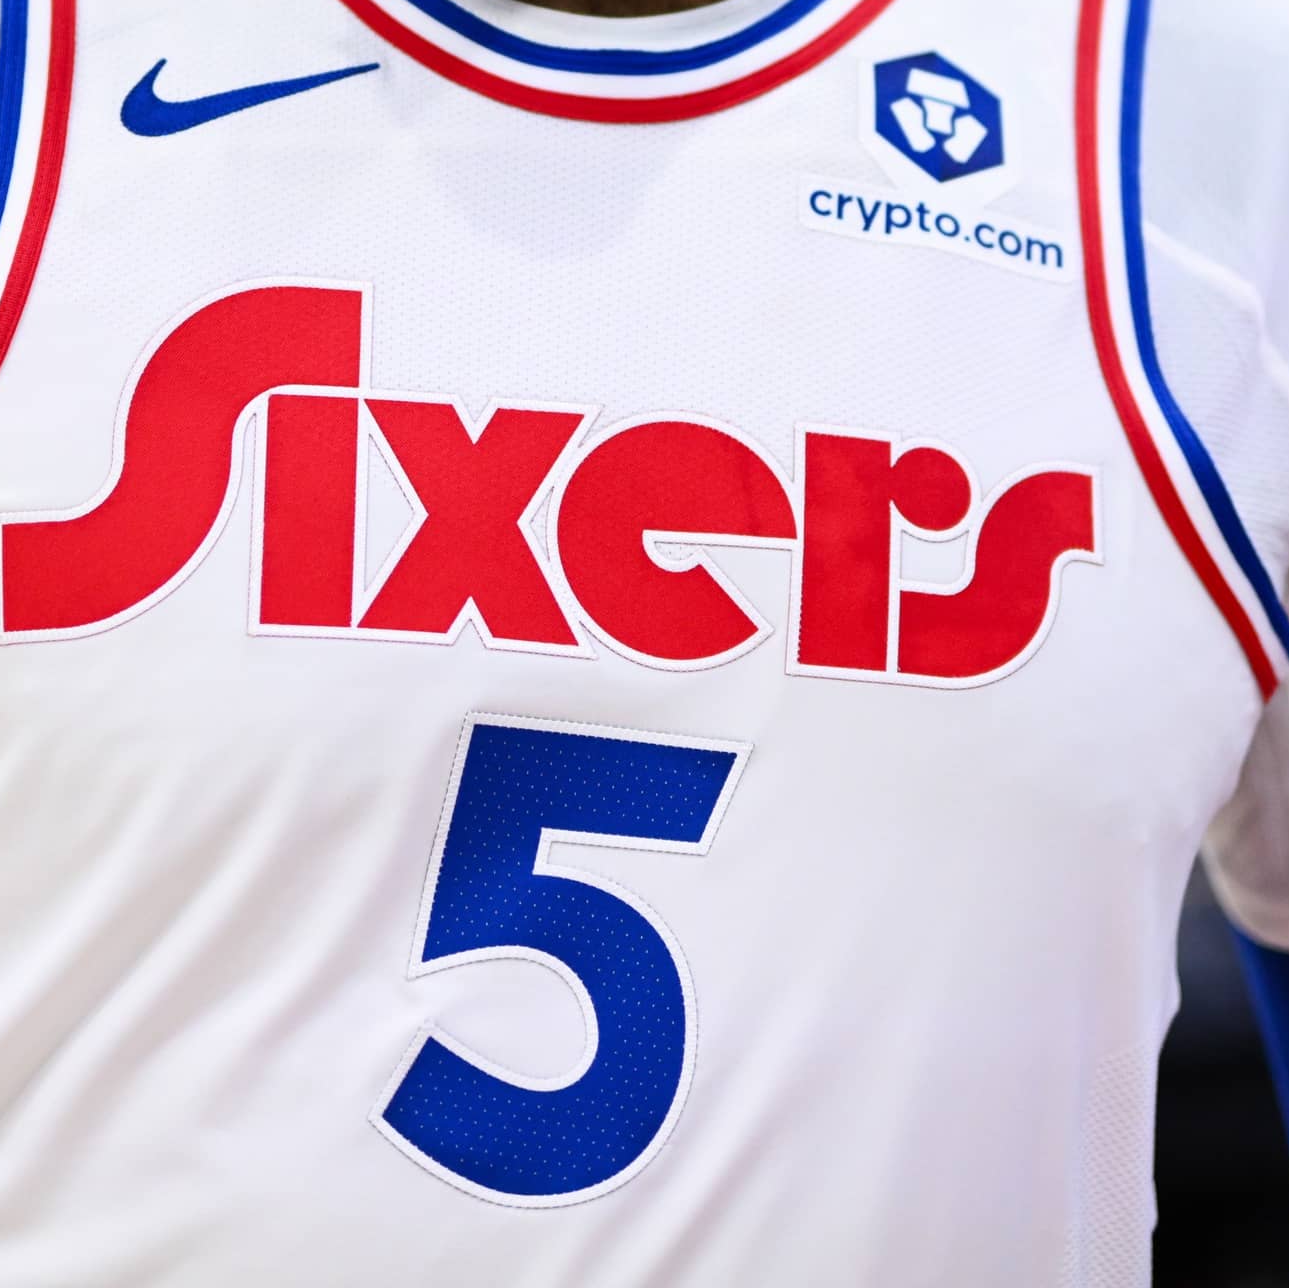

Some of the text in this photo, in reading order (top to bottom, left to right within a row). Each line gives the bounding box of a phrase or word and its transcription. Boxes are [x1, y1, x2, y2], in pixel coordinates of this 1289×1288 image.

[809, 189, 1063, 268] crypto.com
[0, 285, 1096, 679] Sixers
[380, 723, 738, 1198] 5
